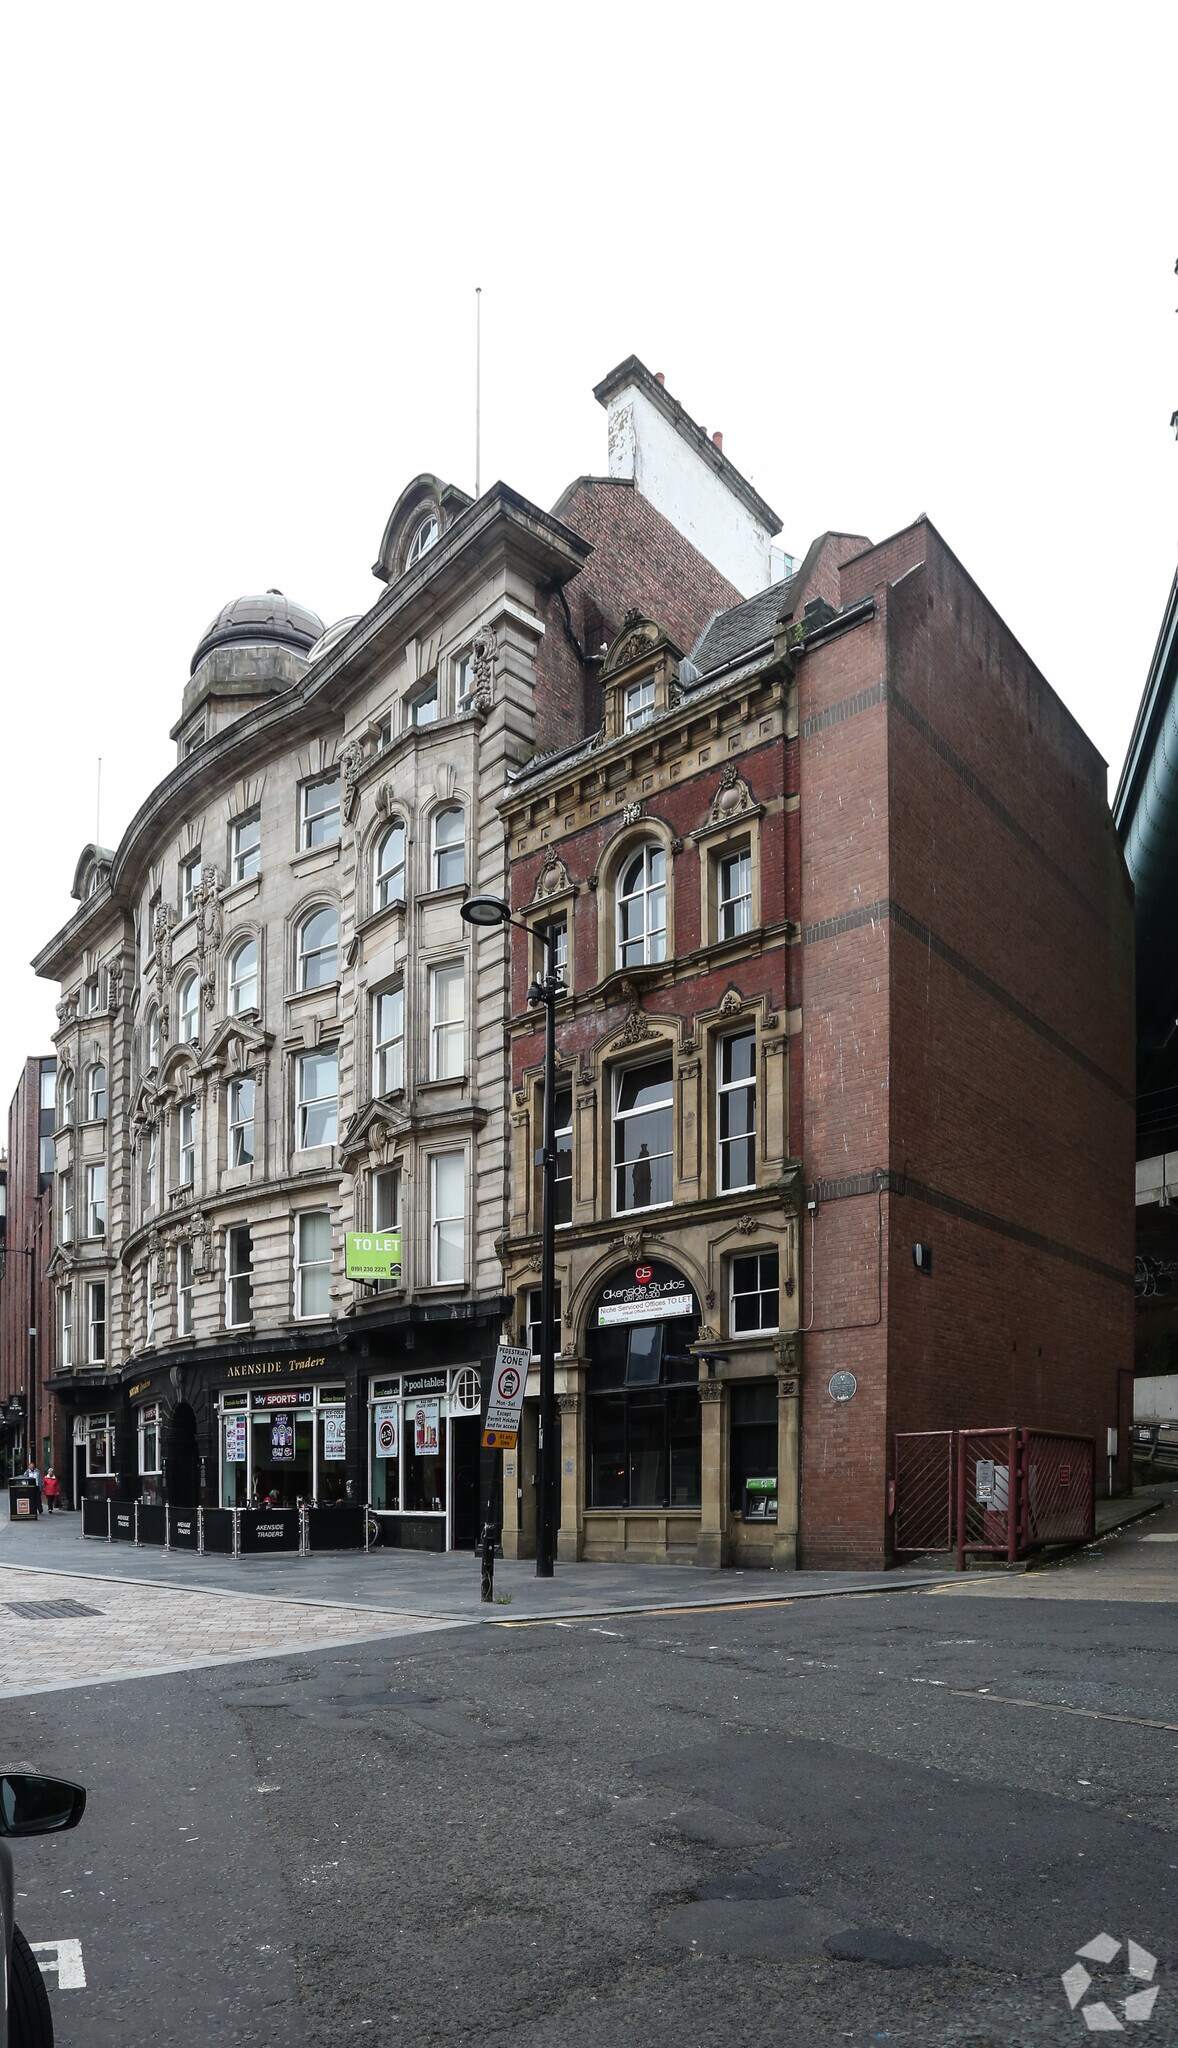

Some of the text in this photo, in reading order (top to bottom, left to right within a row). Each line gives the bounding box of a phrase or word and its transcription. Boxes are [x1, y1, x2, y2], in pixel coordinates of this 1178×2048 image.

[353, 1238, 401, 1252] TO LET
[600, 1304, 617, 1314] Niche
[618, 1301, 644, 1312] Serviced
[645, 1299, 666, 1308] Offices
[678, 1295, 692, 1304] LET
[499, 1347, 529, 1356] PEDESTRIAN
[289, 1356, 326, 1372] Traders
[502, 1356, 522, 1366] ZONE
[408, 1376, 445, 1392] pool tables
[255, 1394, 266, 1405] sky
[267, 1394, 296, 1405] SPORTS
[298, 1392, 312, 1402] HD
